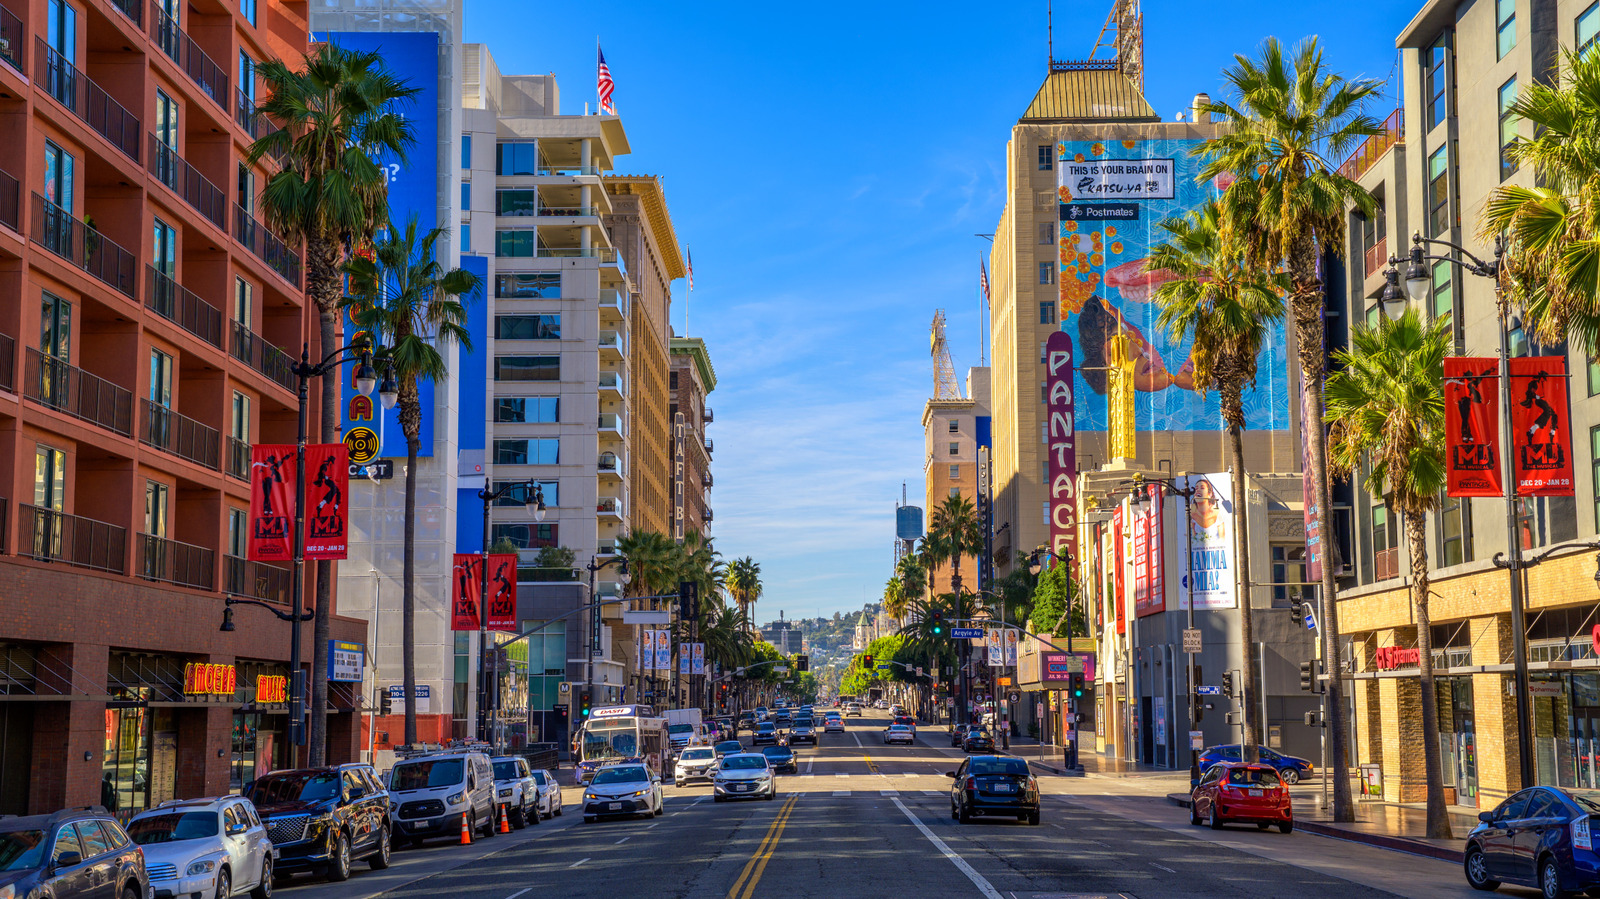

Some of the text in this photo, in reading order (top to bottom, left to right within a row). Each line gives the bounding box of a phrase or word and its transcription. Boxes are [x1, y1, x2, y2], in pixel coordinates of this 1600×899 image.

[1069, 164, 1167, 175] THIS IS YOUR BRAIN ON
[1087, 183, 1142, 194] KATSU-YA
[1086, 207, 1134, 217] Postmates
[1049, 350, 1076, 570] PANTAGE
[1458, 445, 1489, 465] MJ
[1526, 444, 1559, 464] MJ
[676, 423, 684, 540] TAFT BL
[1194, 571, 1219, 591] MIA!
[1376, 646, 1393, 669] CVS
[184, 662, 236, 695] AMOEBA
[256, 674, 287, 703] MUSIC
